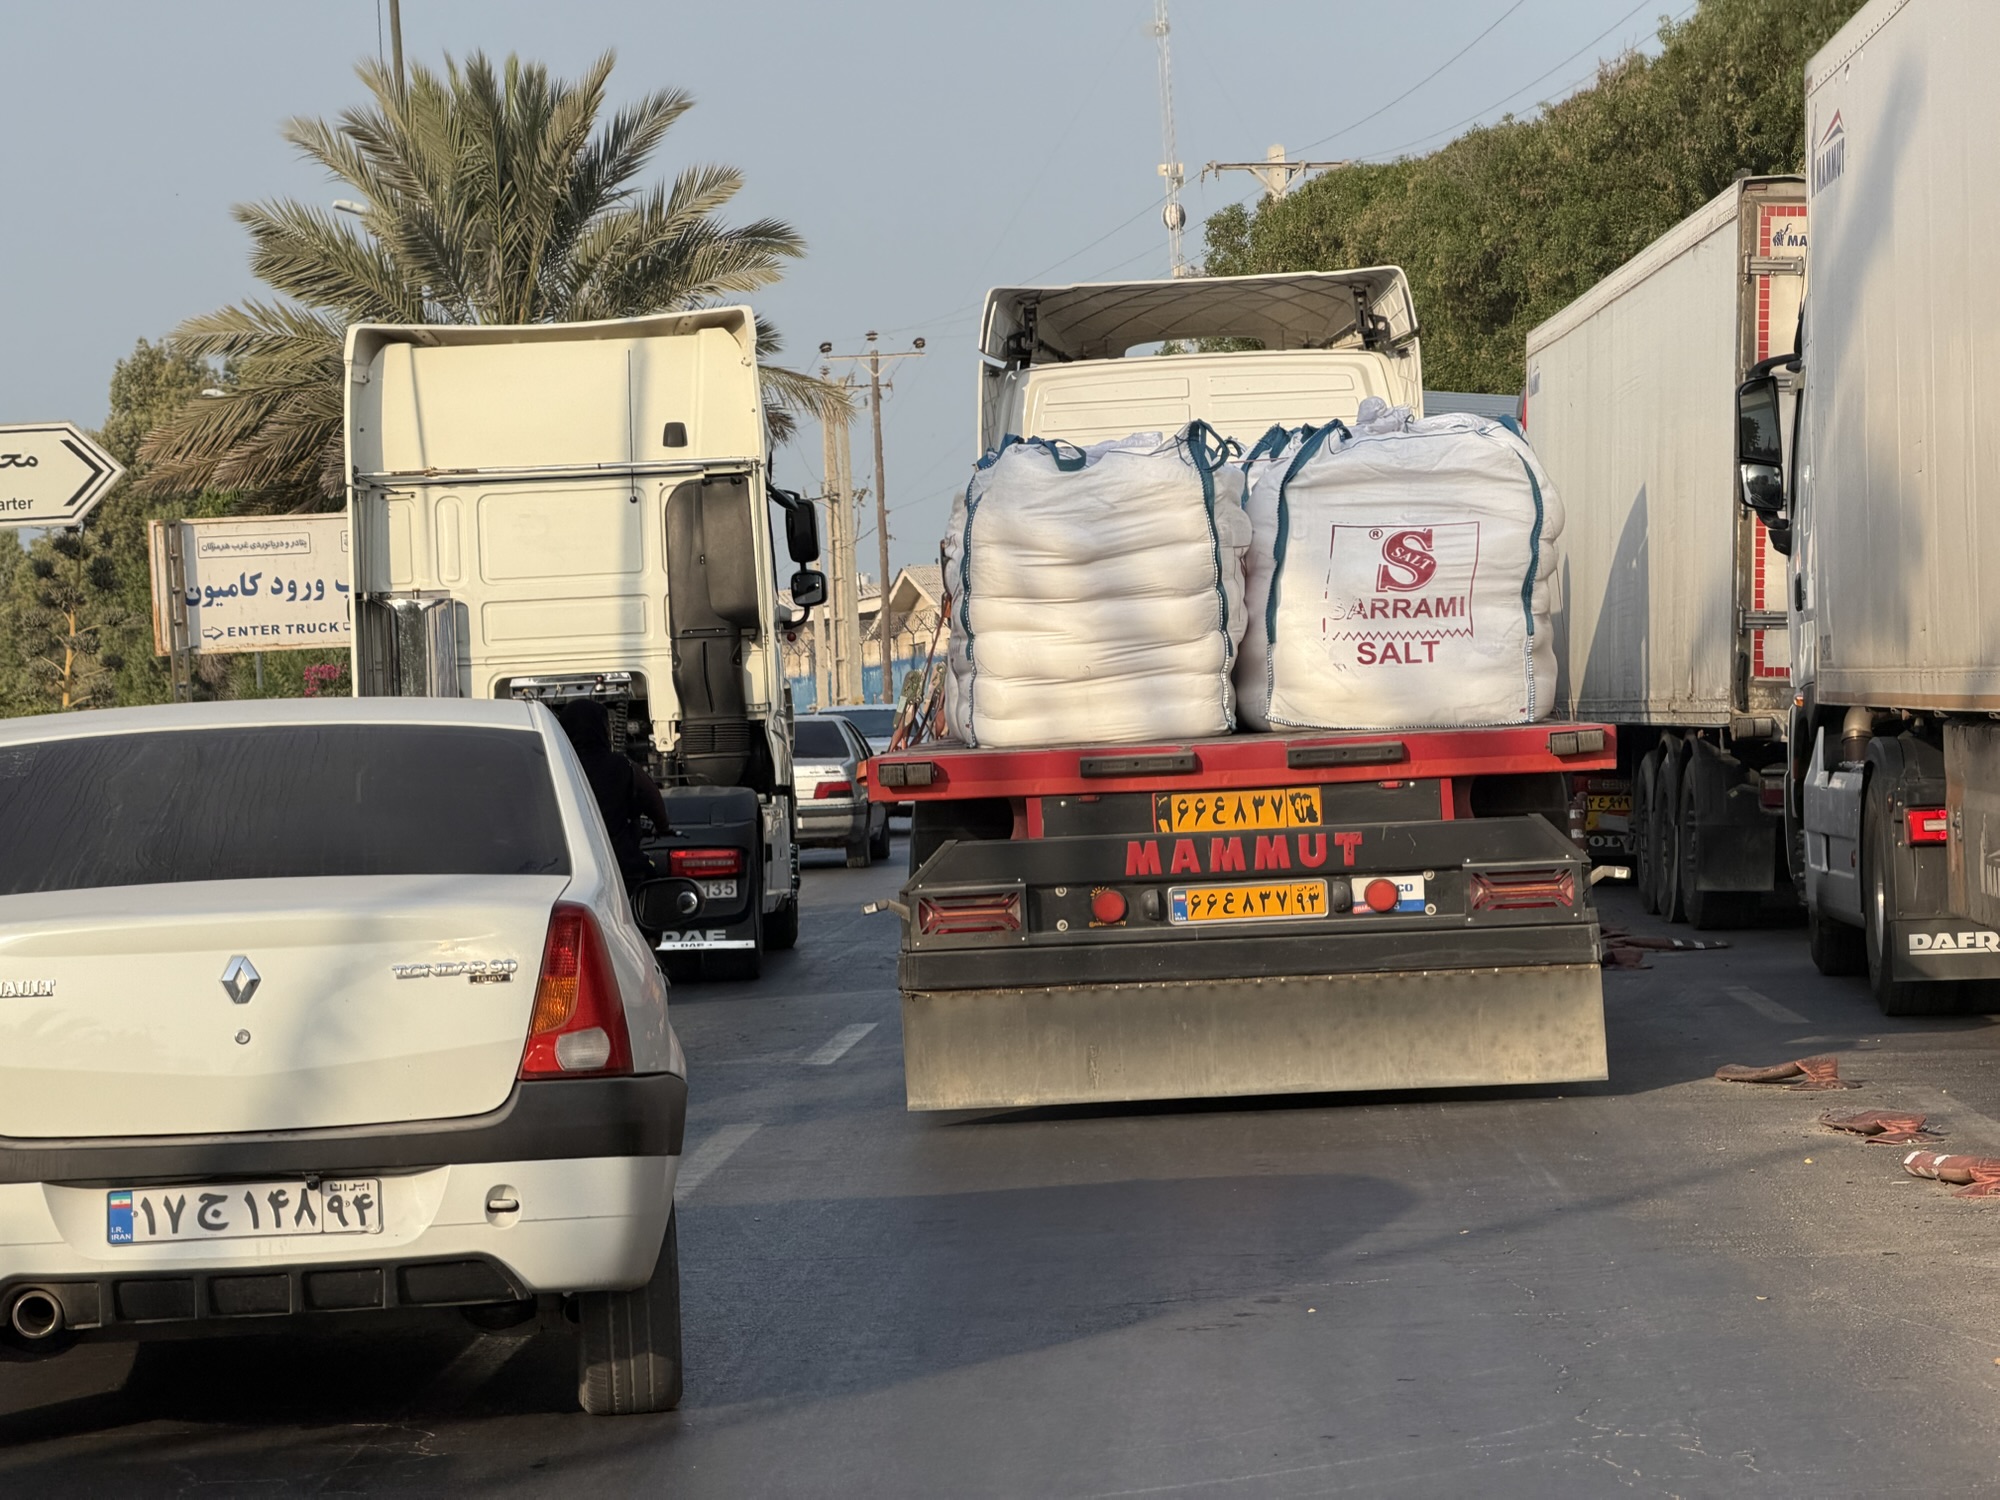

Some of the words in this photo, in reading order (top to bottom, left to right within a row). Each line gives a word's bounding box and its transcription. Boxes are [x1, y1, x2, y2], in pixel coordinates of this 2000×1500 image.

[1391, 547, 1434, 570] SALT
[185, 571, 263, 608] کامیون
[270, 576, 325, 602] ورود
[227, 625, 280, 637] ENTER
[286, 622, 339, 635] TRUCK
[1357, 640, 1440, 665] SALT
[1125, 832, 1362, 877] MAMMUT
[392, 960, 487, 979] TONDAR
[490, 959, 518, 974] 90
[0, 979, 56, 997] AULT
